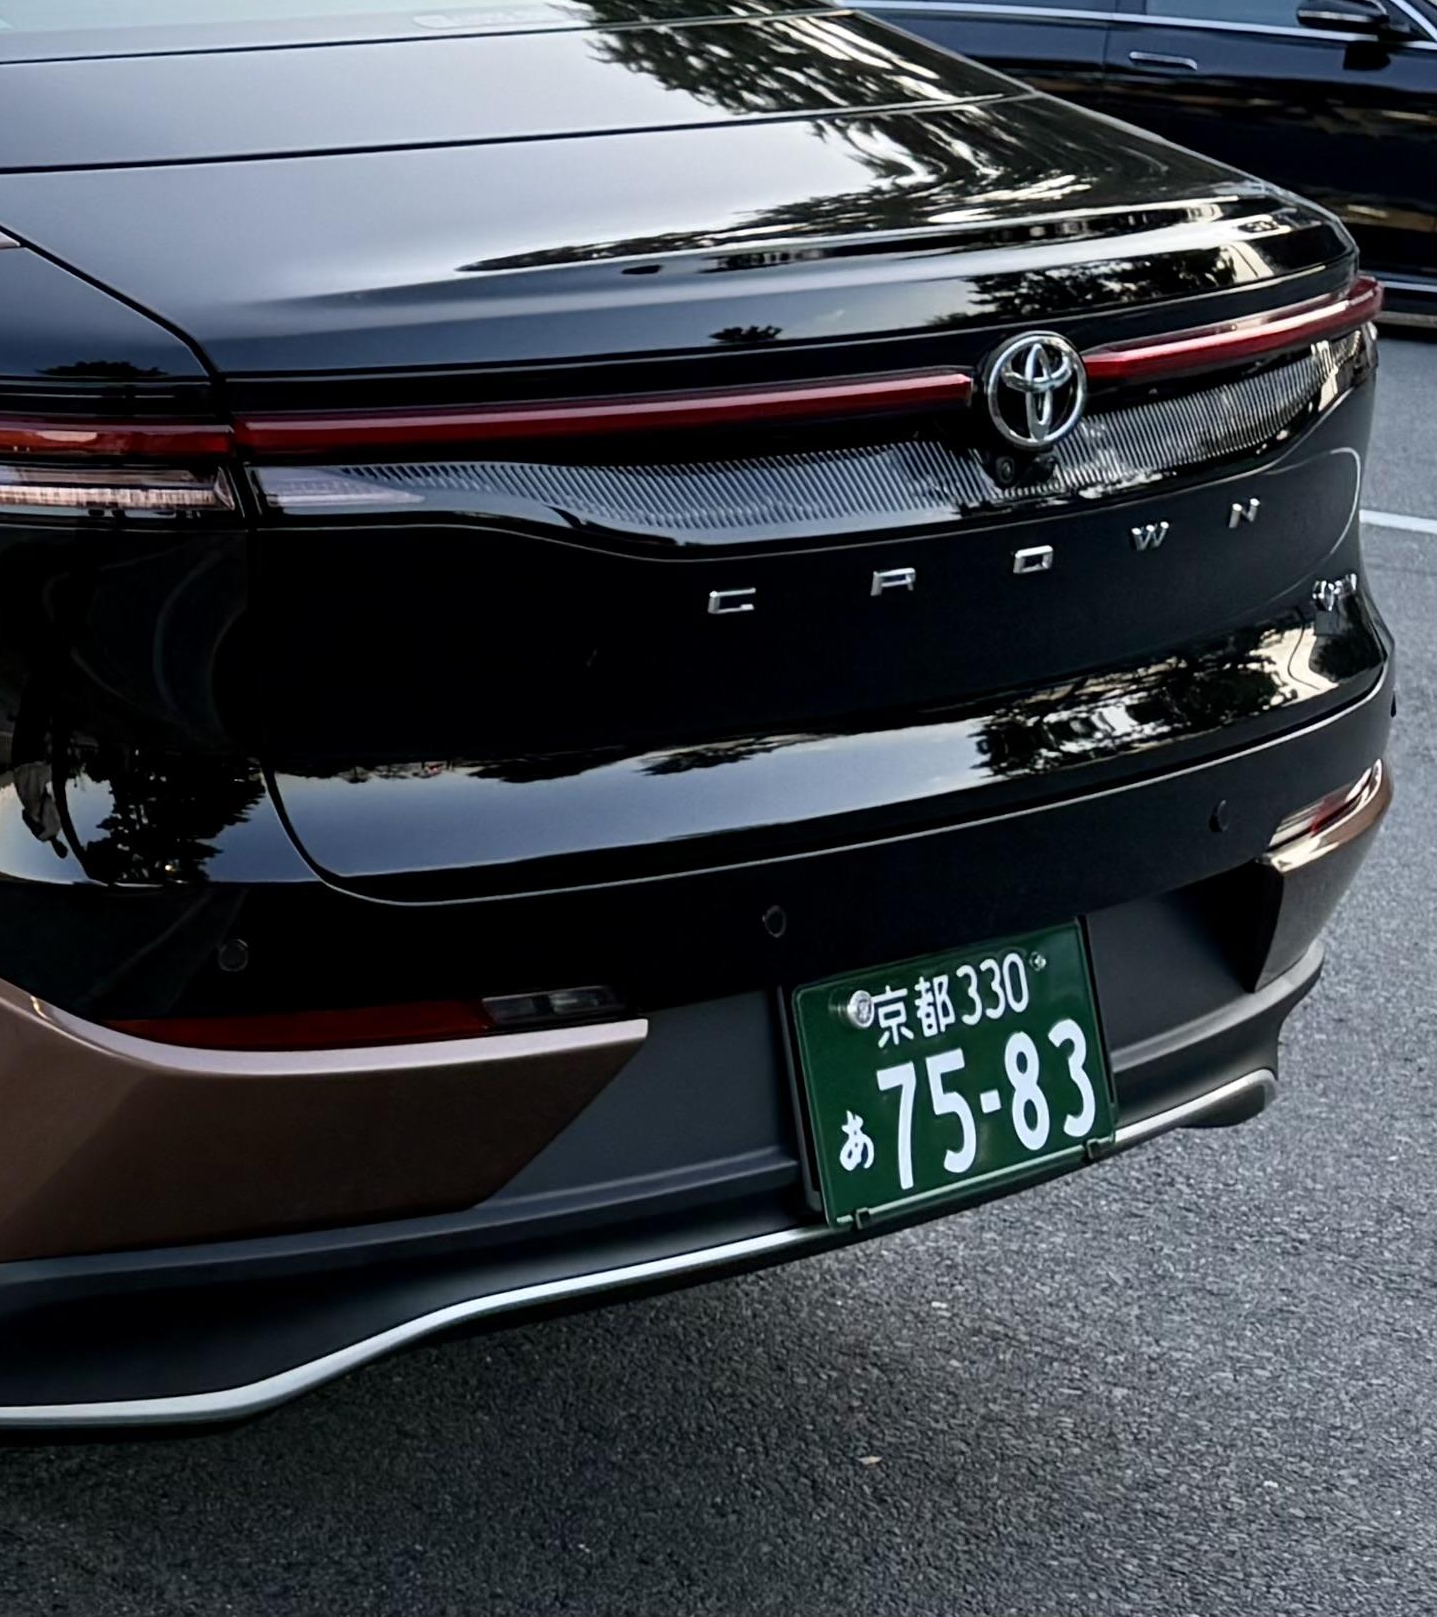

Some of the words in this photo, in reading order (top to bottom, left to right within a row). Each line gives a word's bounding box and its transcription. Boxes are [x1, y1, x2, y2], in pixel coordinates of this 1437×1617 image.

[708, 497, 1260, 614] CROWN
[839, 1109, 875, 1171] あ
[876, 1019, 1096, 1190] 75-83
